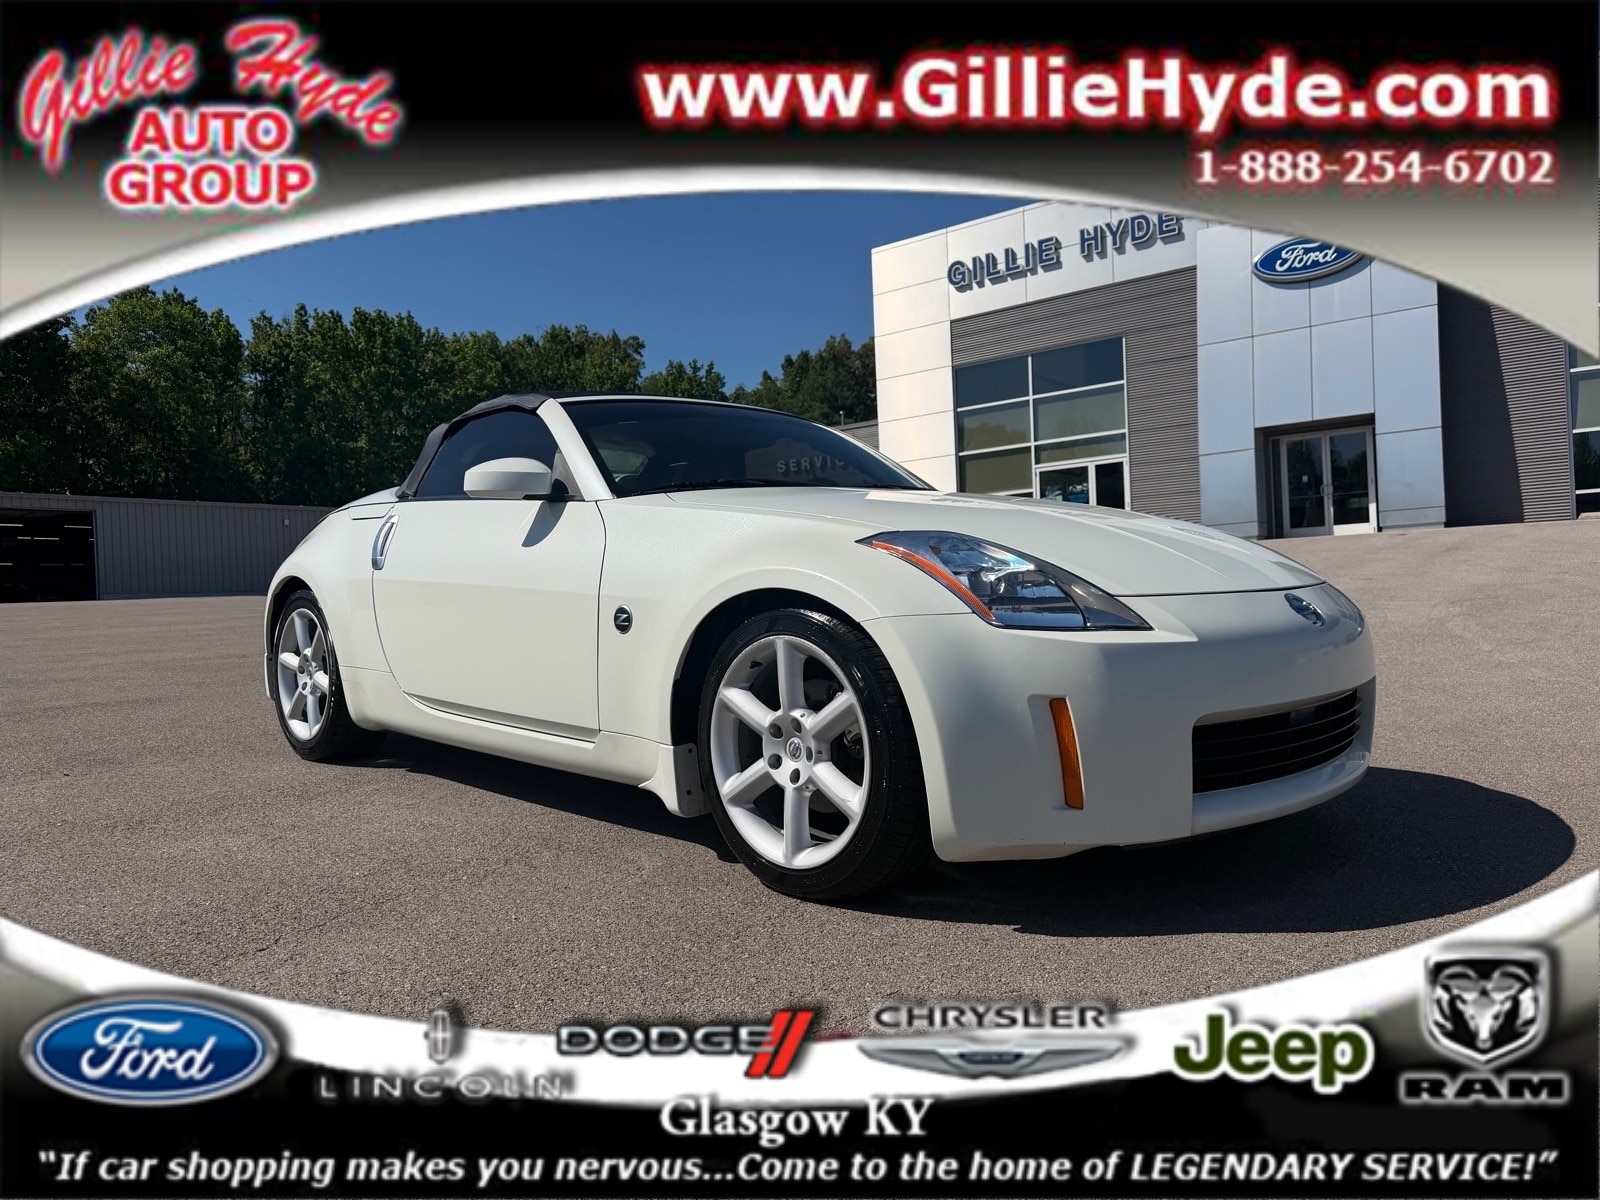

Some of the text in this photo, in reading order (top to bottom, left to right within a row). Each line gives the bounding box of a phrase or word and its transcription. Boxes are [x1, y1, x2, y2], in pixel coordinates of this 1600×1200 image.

[947, 212, 1179, 287] GILLIE HYDE
[1275, 241, 1338, 272] Ford
